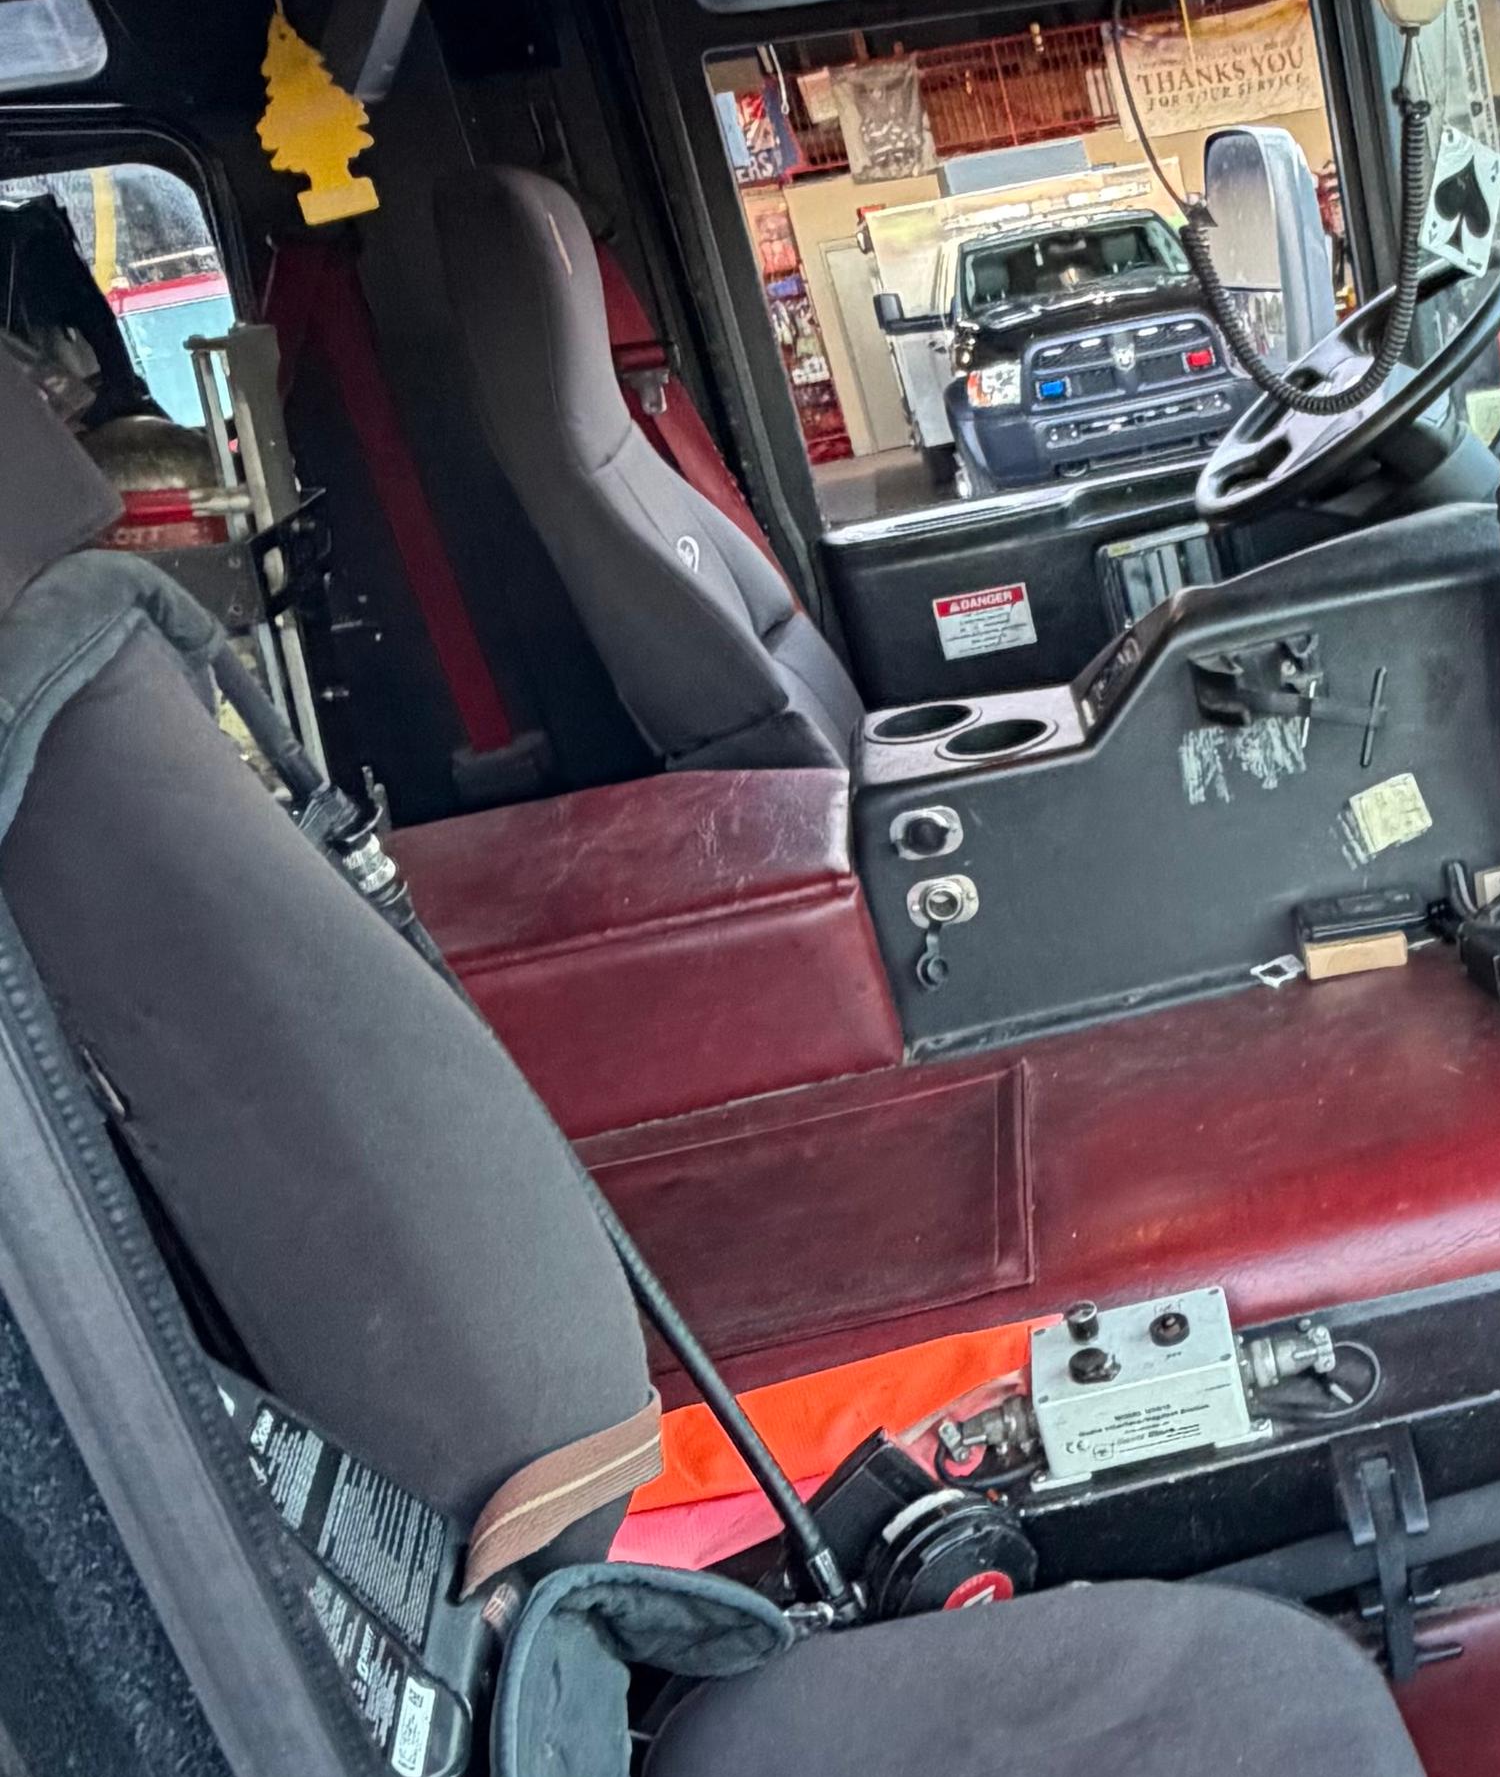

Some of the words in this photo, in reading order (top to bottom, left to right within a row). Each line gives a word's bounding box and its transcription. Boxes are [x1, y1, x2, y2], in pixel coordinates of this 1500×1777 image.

[1137, 59, 1246, 96] THANKS
[1251, 46, 1304, 77] YOU
[960, 590, 1013, 611] DANGER
